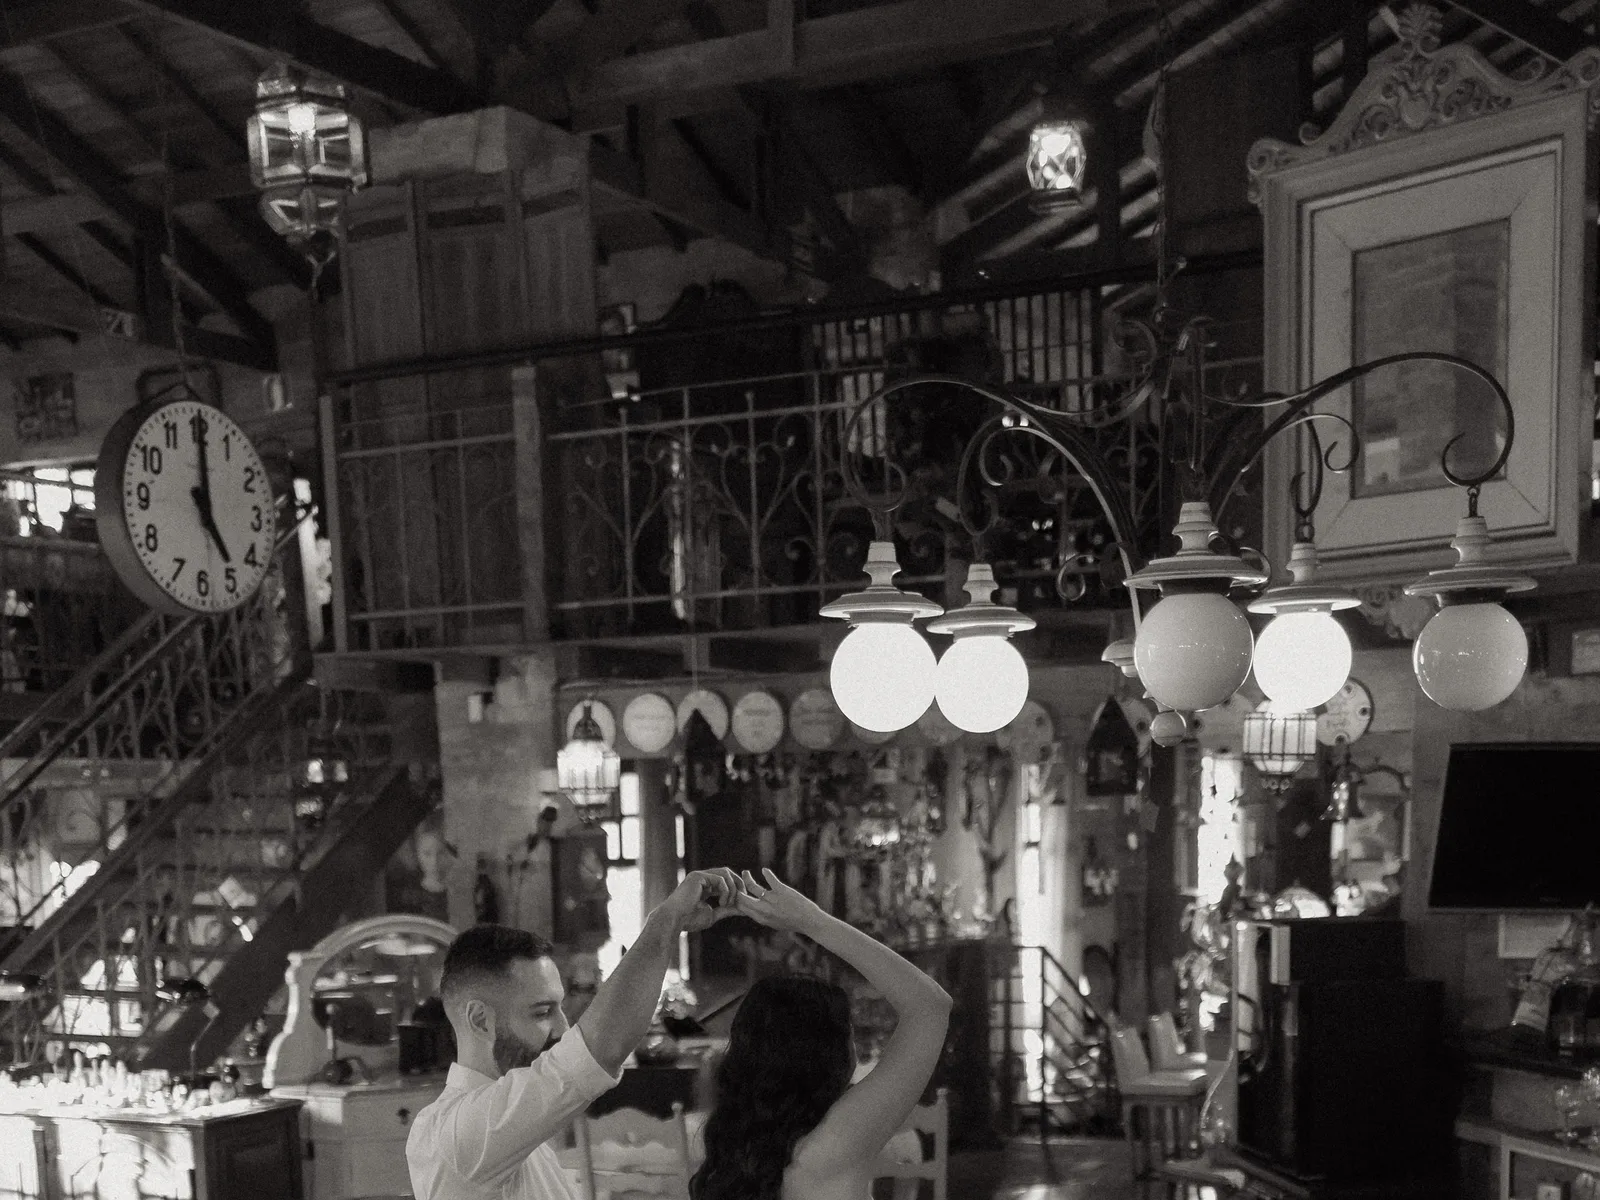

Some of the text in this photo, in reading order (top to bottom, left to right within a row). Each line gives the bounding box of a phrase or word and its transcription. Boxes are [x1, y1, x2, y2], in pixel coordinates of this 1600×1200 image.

[163, 420, 178, 450] 11
[223, 434, 231, 461] 1
[140, 445, 162, 475] 10
[243, 467, 255, 494] 2
[137, 483, 150, 511] 9
[251, 505, 262, 532] 3
[145, 524, 158, 552] 8
[243, 543, 258, 568] 4
[172, 557, 186, 582] 7
[225, 568, 237, 593] 5
[197, 570, 209, 597] 6
